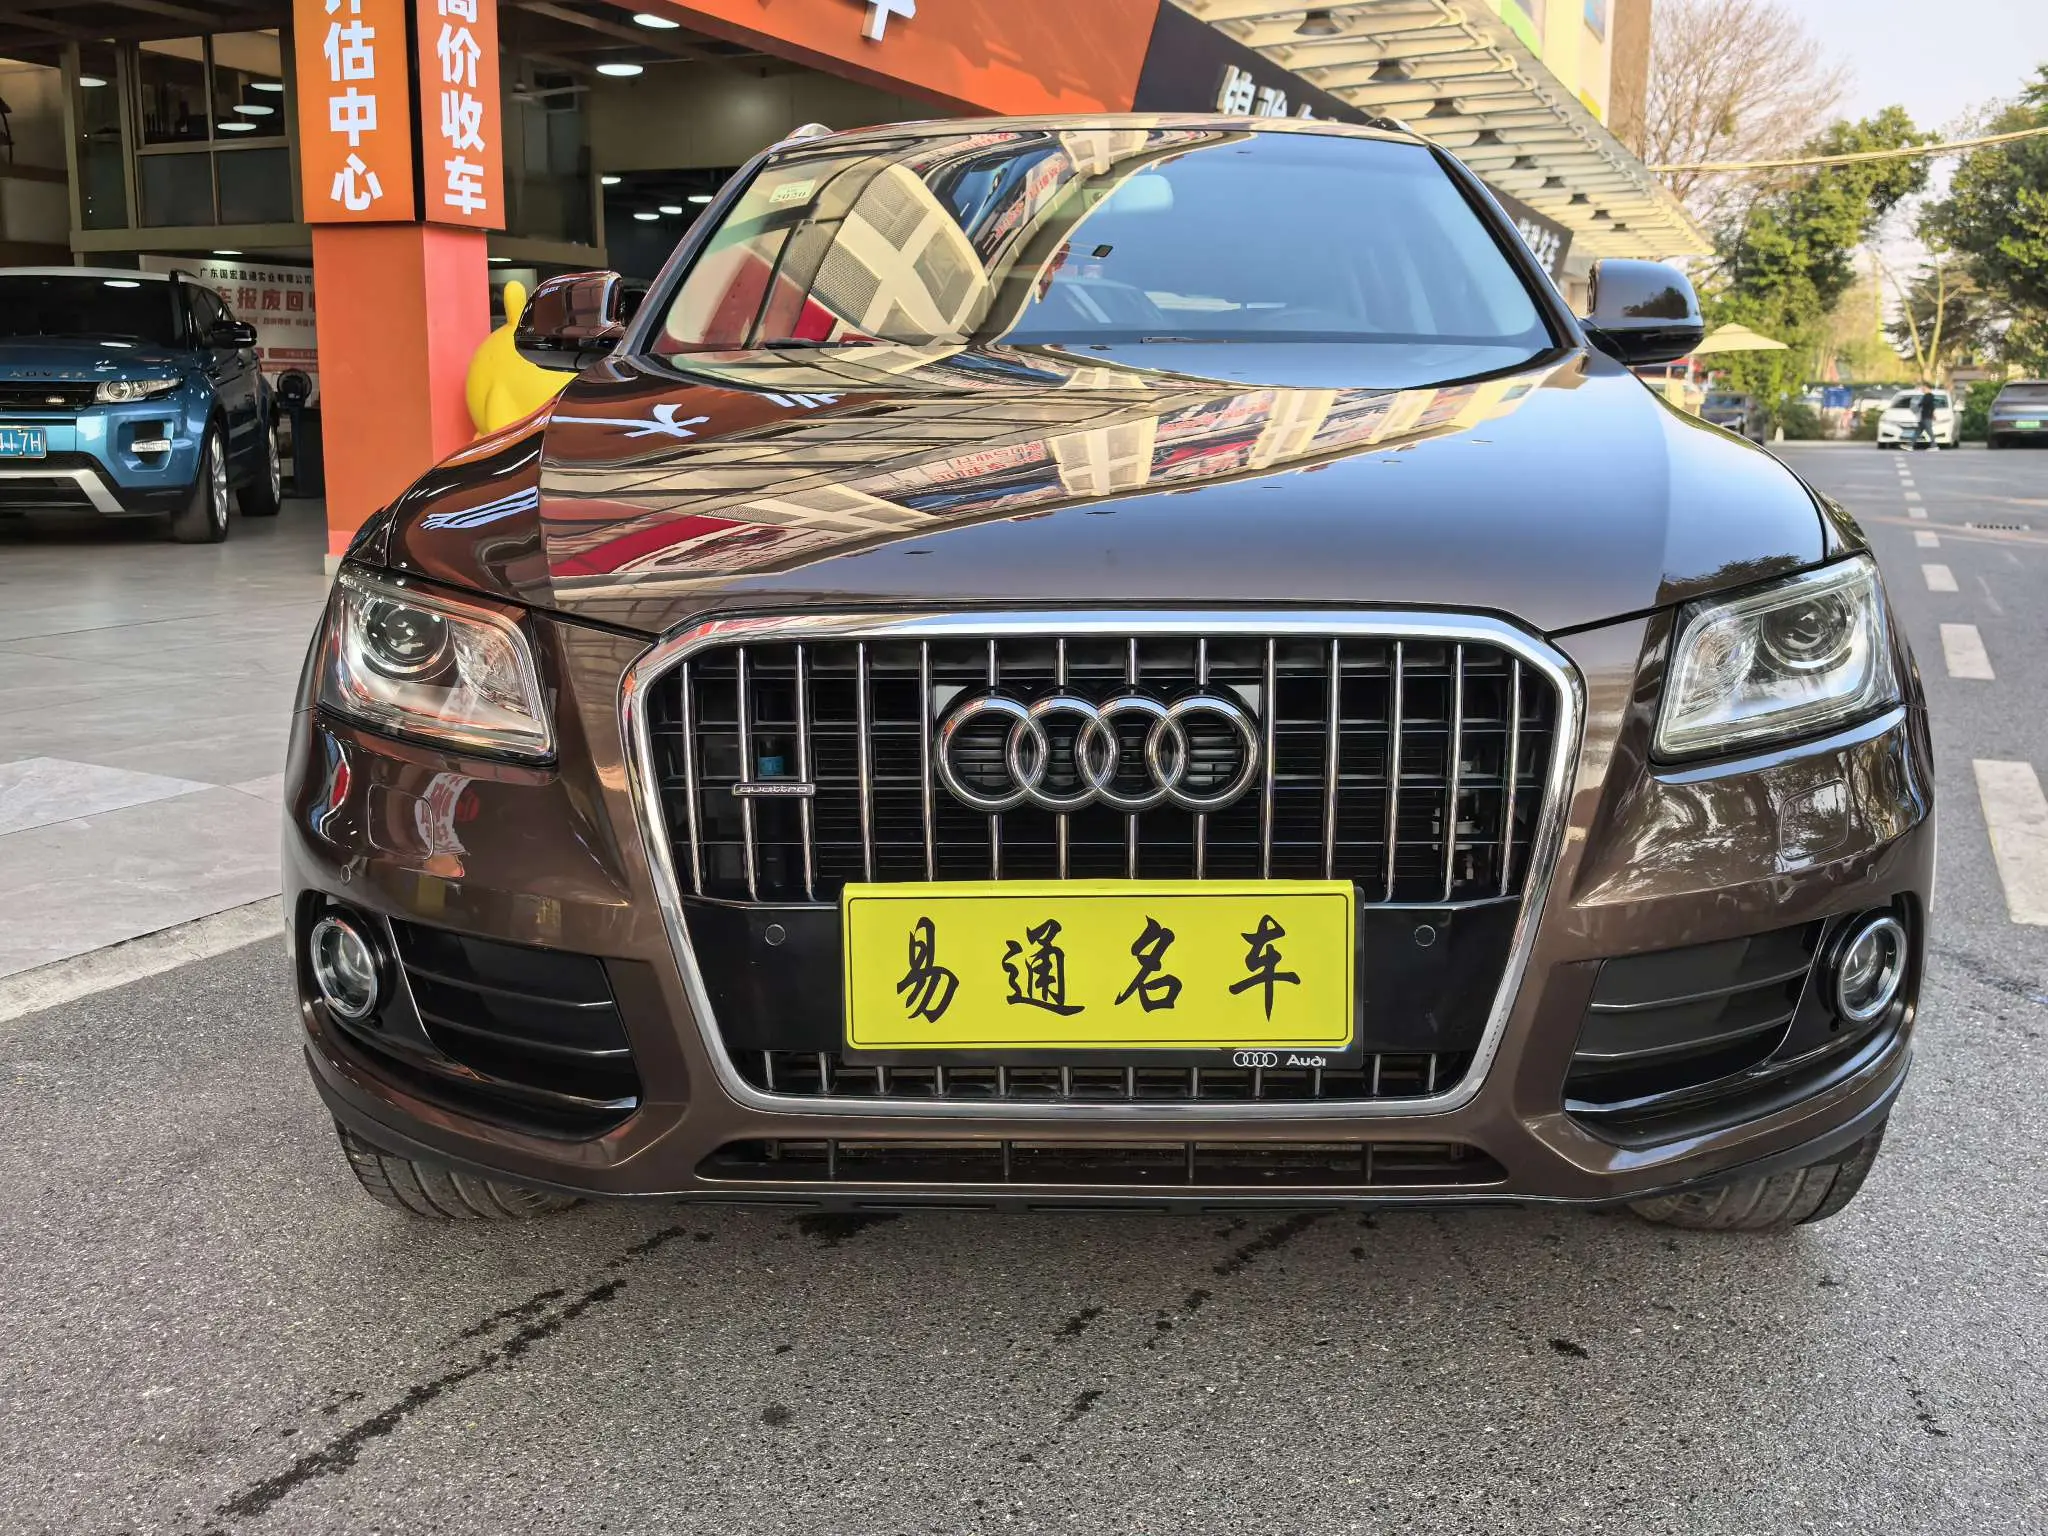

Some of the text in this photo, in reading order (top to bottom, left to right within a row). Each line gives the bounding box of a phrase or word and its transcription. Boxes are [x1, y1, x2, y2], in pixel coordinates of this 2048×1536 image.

[215, 286, 317, 312] 车报废回
[739, 785, 808, 793] quattro
[896, 914, 1301, 1023] 易通名车
[1286, 1054, 1327, 1067] Audi
